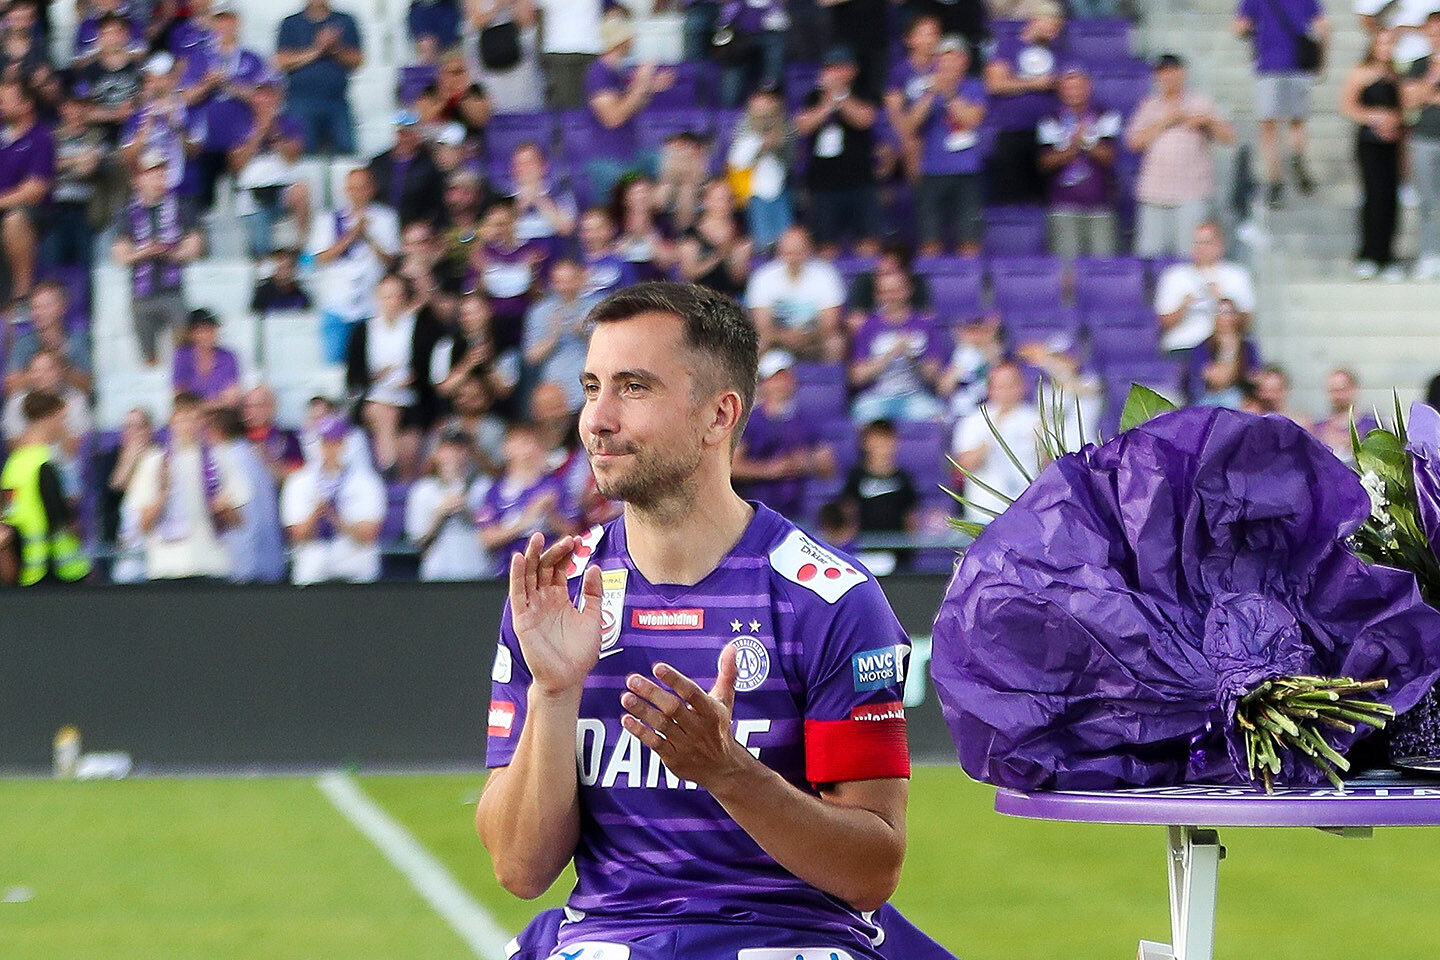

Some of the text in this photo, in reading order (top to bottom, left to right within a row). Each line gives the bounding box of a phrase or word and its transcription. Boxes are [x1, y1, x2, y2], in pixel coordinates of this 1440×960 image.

[638, 613, 699, 626] wienholding
[858, 652, 893, 673] MVC
[576, 718, 772, 790] DANE
